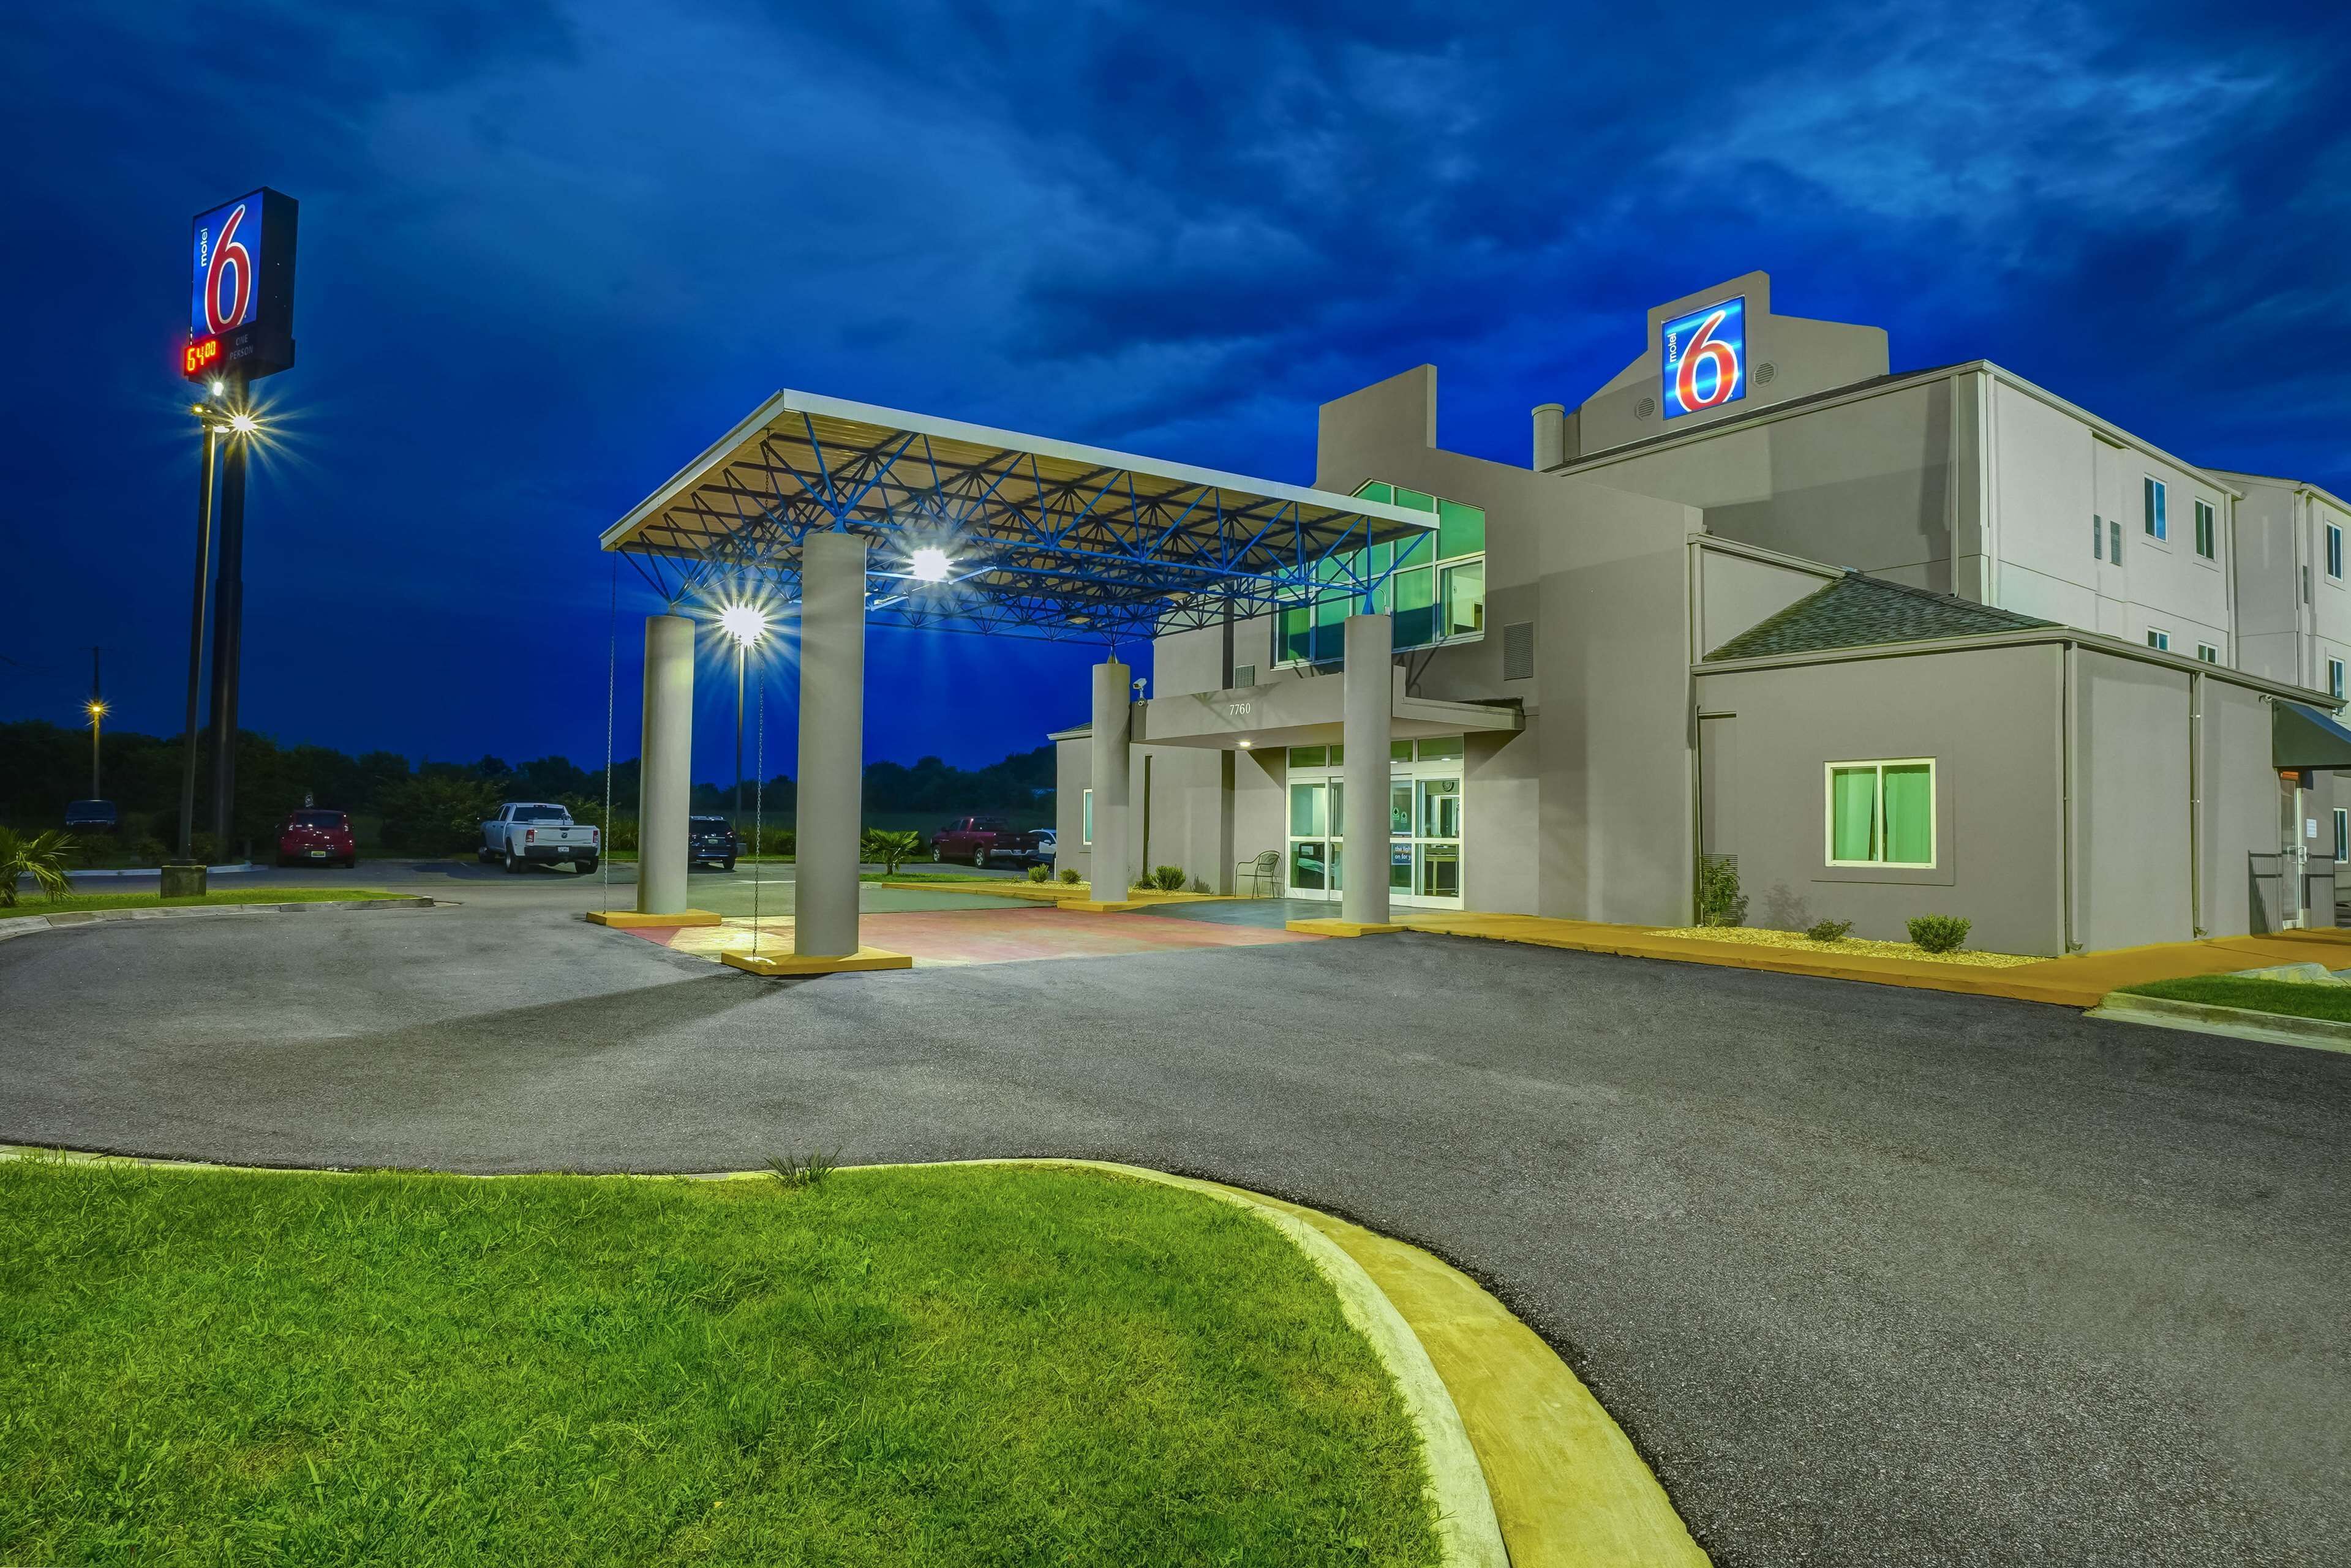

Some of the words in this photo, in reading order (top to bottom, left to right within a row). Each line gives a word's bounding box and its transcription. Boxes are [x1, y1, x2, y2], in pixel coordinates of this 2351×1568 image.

[205, 204, 251, 334] 6
[236, 334, 248, 346] ONE
[1668, 332, 1677, 362] motel
[230, 345, 254, 360] PERSON
[1676, 310, 1739, 412] 6
[1230, 702, 1251, 715] 7760
